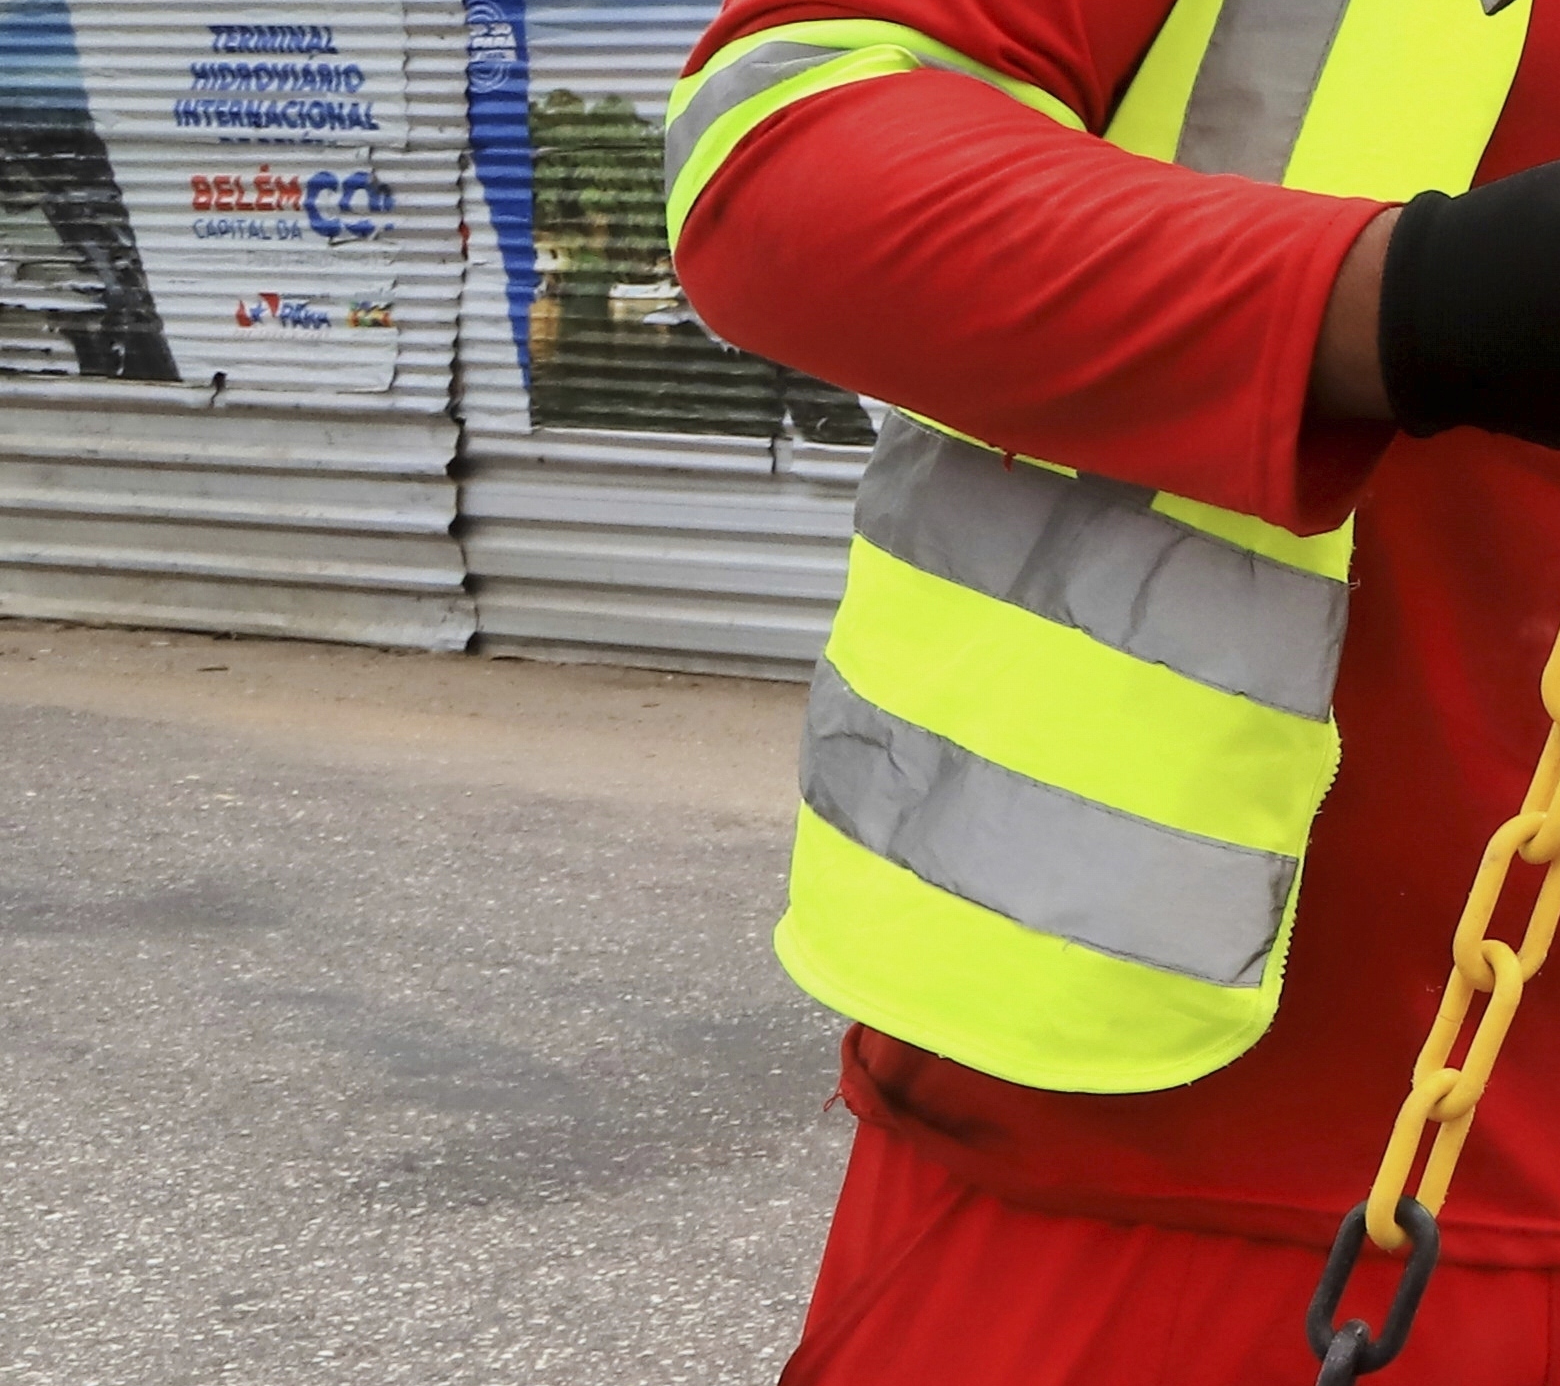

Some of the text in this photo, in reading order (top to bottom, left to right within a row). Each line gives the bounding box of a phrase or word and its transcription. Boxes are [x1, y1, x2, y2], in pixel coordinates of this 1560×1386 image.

[208, 25, 338, 54] TERMINAL
[174, 99, 380, 130] INTERNACIONAL
[190, 163, 302, 211] BELÉM
[193, 218, 303, 240] CAPITAL DA
